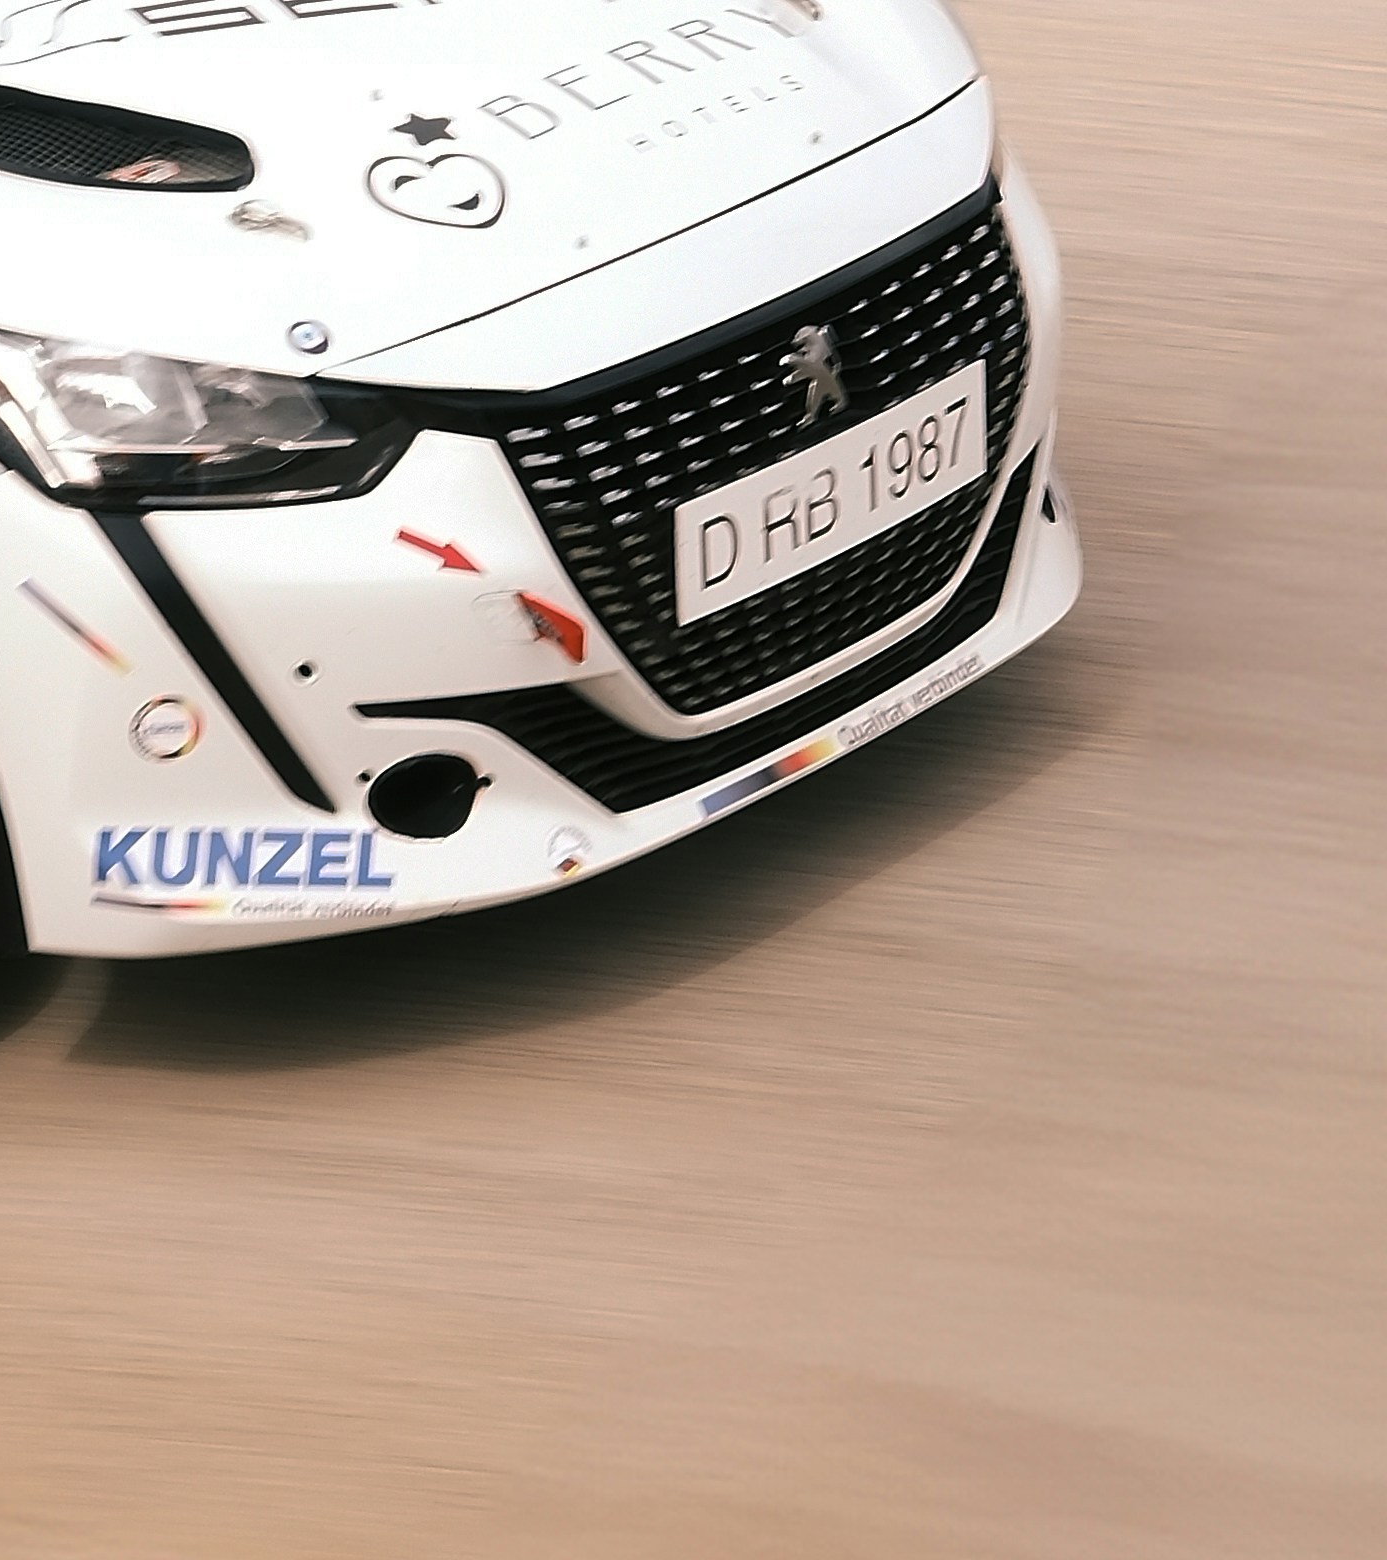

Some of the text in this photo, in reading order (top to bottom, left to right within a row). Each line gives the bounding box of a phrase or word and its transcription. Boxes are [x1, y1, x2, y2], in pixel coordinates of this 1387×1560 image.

[477, 8, 799, 142] BERRY
[629, 72, 806, 153] HOTELS
[700, 395, 971, 591] D RB 1987
[94, 828, 393, 888] KUNZEL
